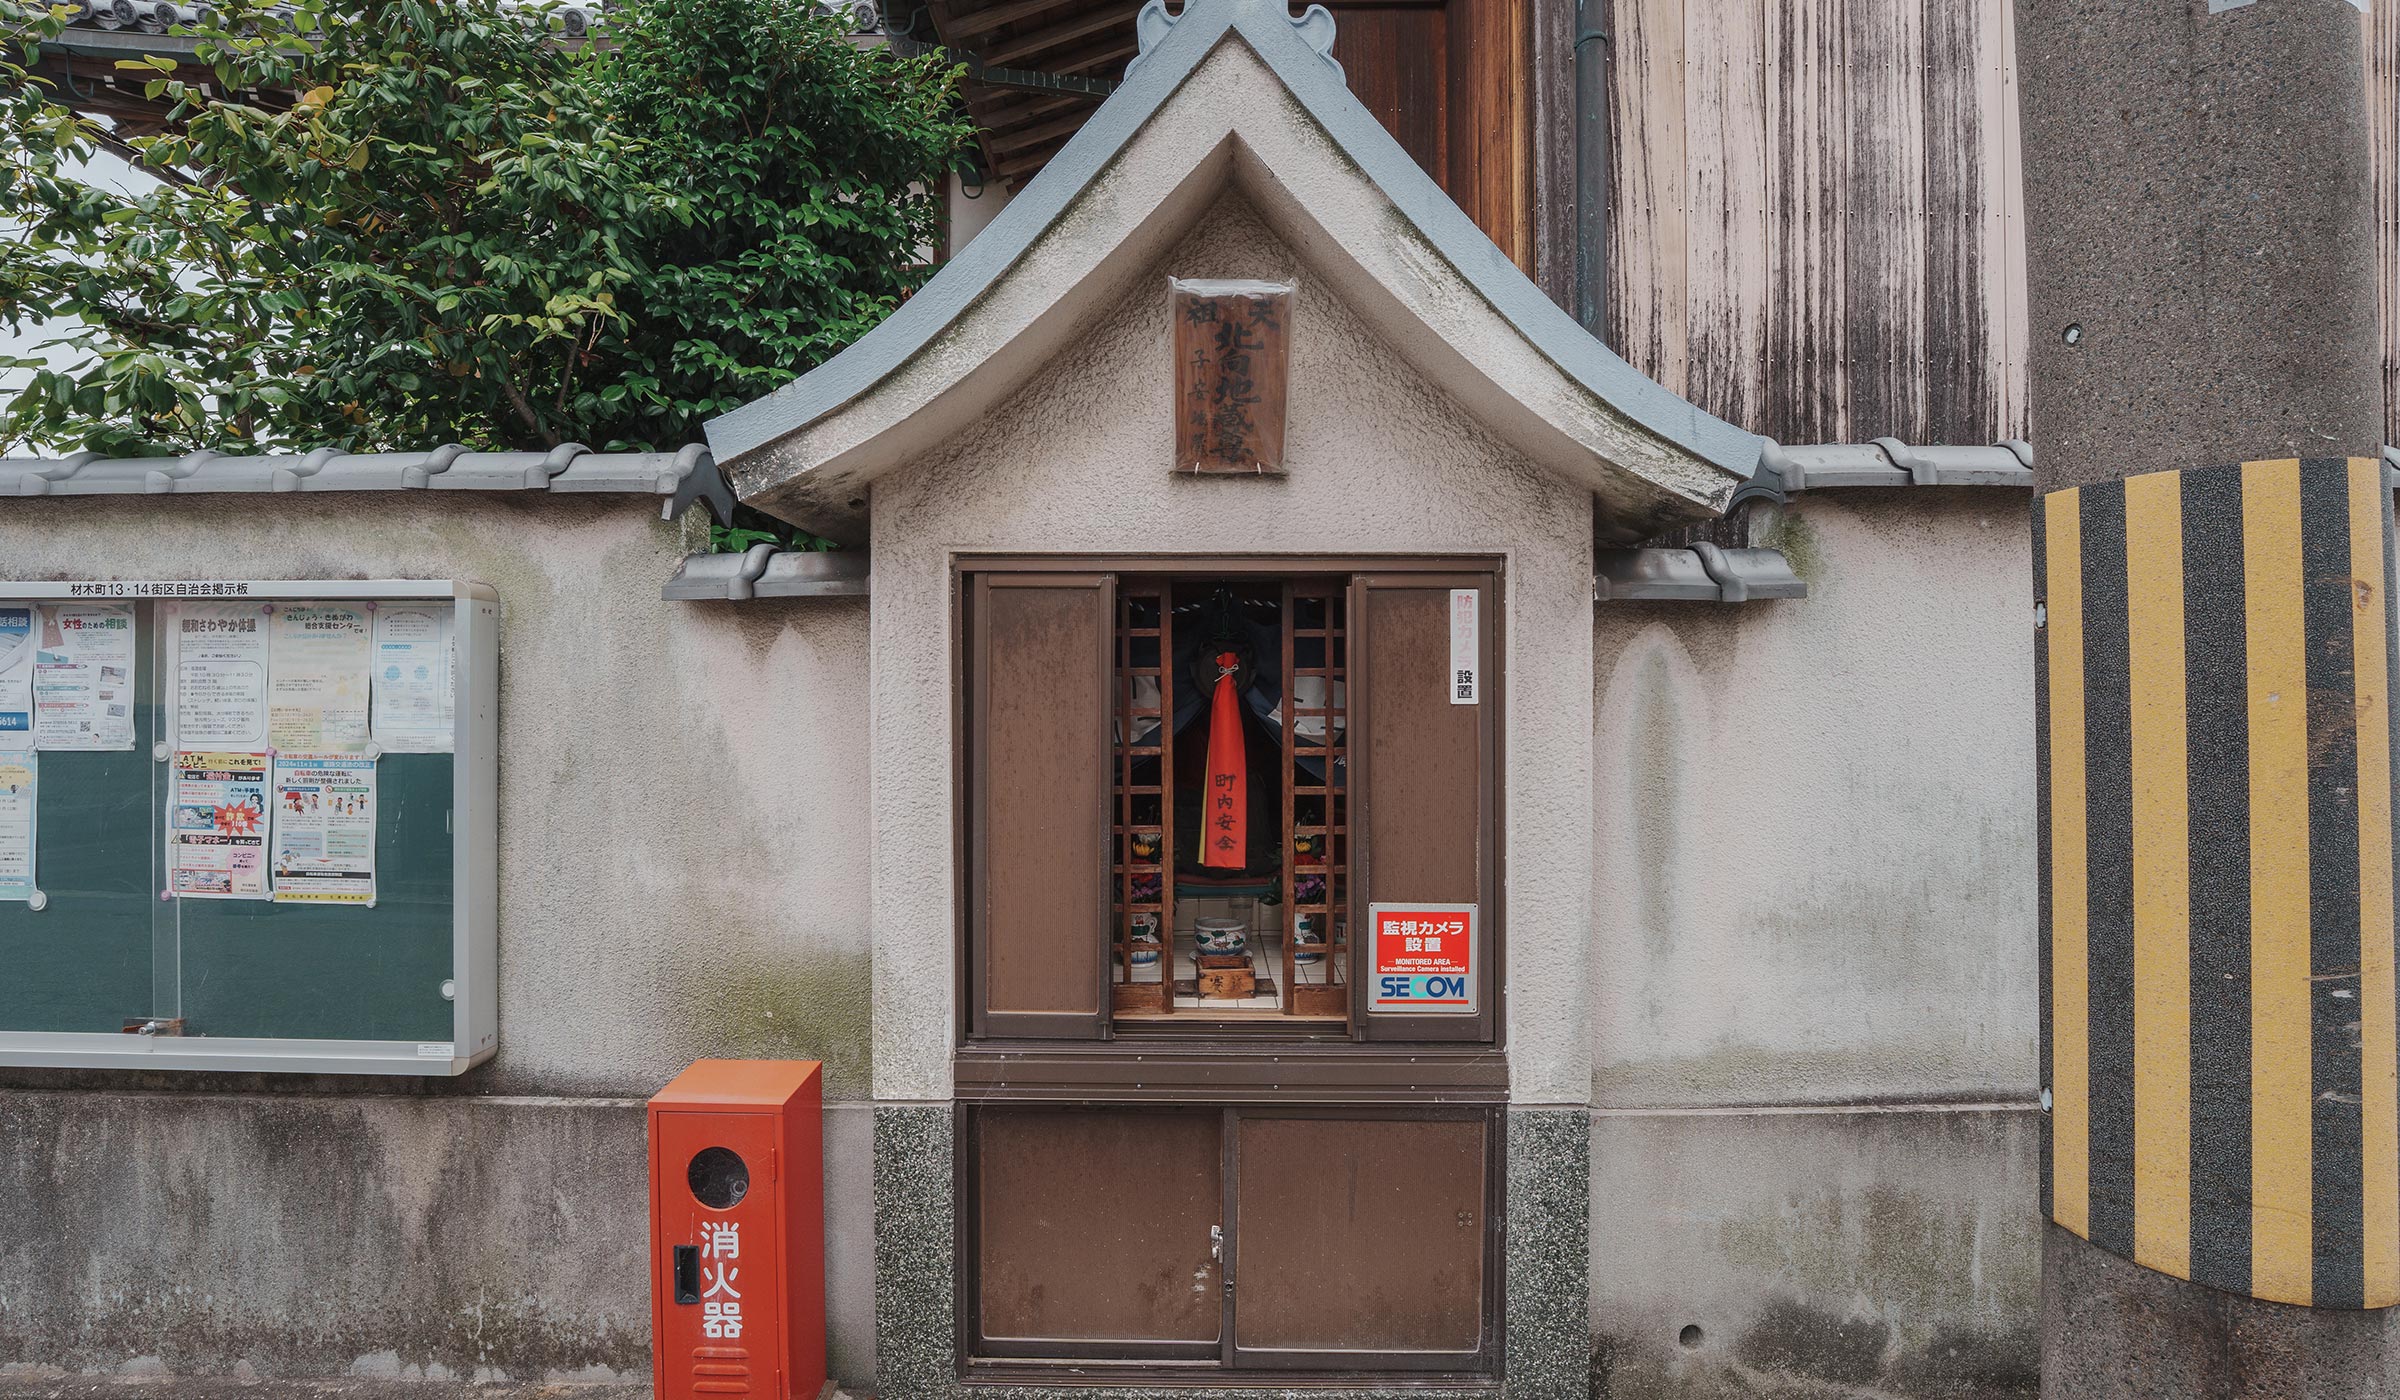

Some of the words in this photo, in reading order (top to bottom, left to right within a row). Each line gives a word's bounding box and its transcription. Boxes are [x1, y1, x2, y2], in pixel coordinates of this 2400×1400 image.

[71, 583, 248, 597] 材木町13・14街区自治会掲示板
[62, 618, 129, 630] 女性のための相談
[1215, 773, 1238, 851] 町内安全
[1382, 920, 1464, 936] 監視カメラ
[1405, 937, 1442, 953] 設置
[1380, 965, 1416, 973] Surveillance
[1395, 958, 1433, 966] MONITORED
[1433, 958, 1451, 966] AREA
[1380, 976, 1465, 999] SECOM
[700, 1221, 743, 1339] 消火器
